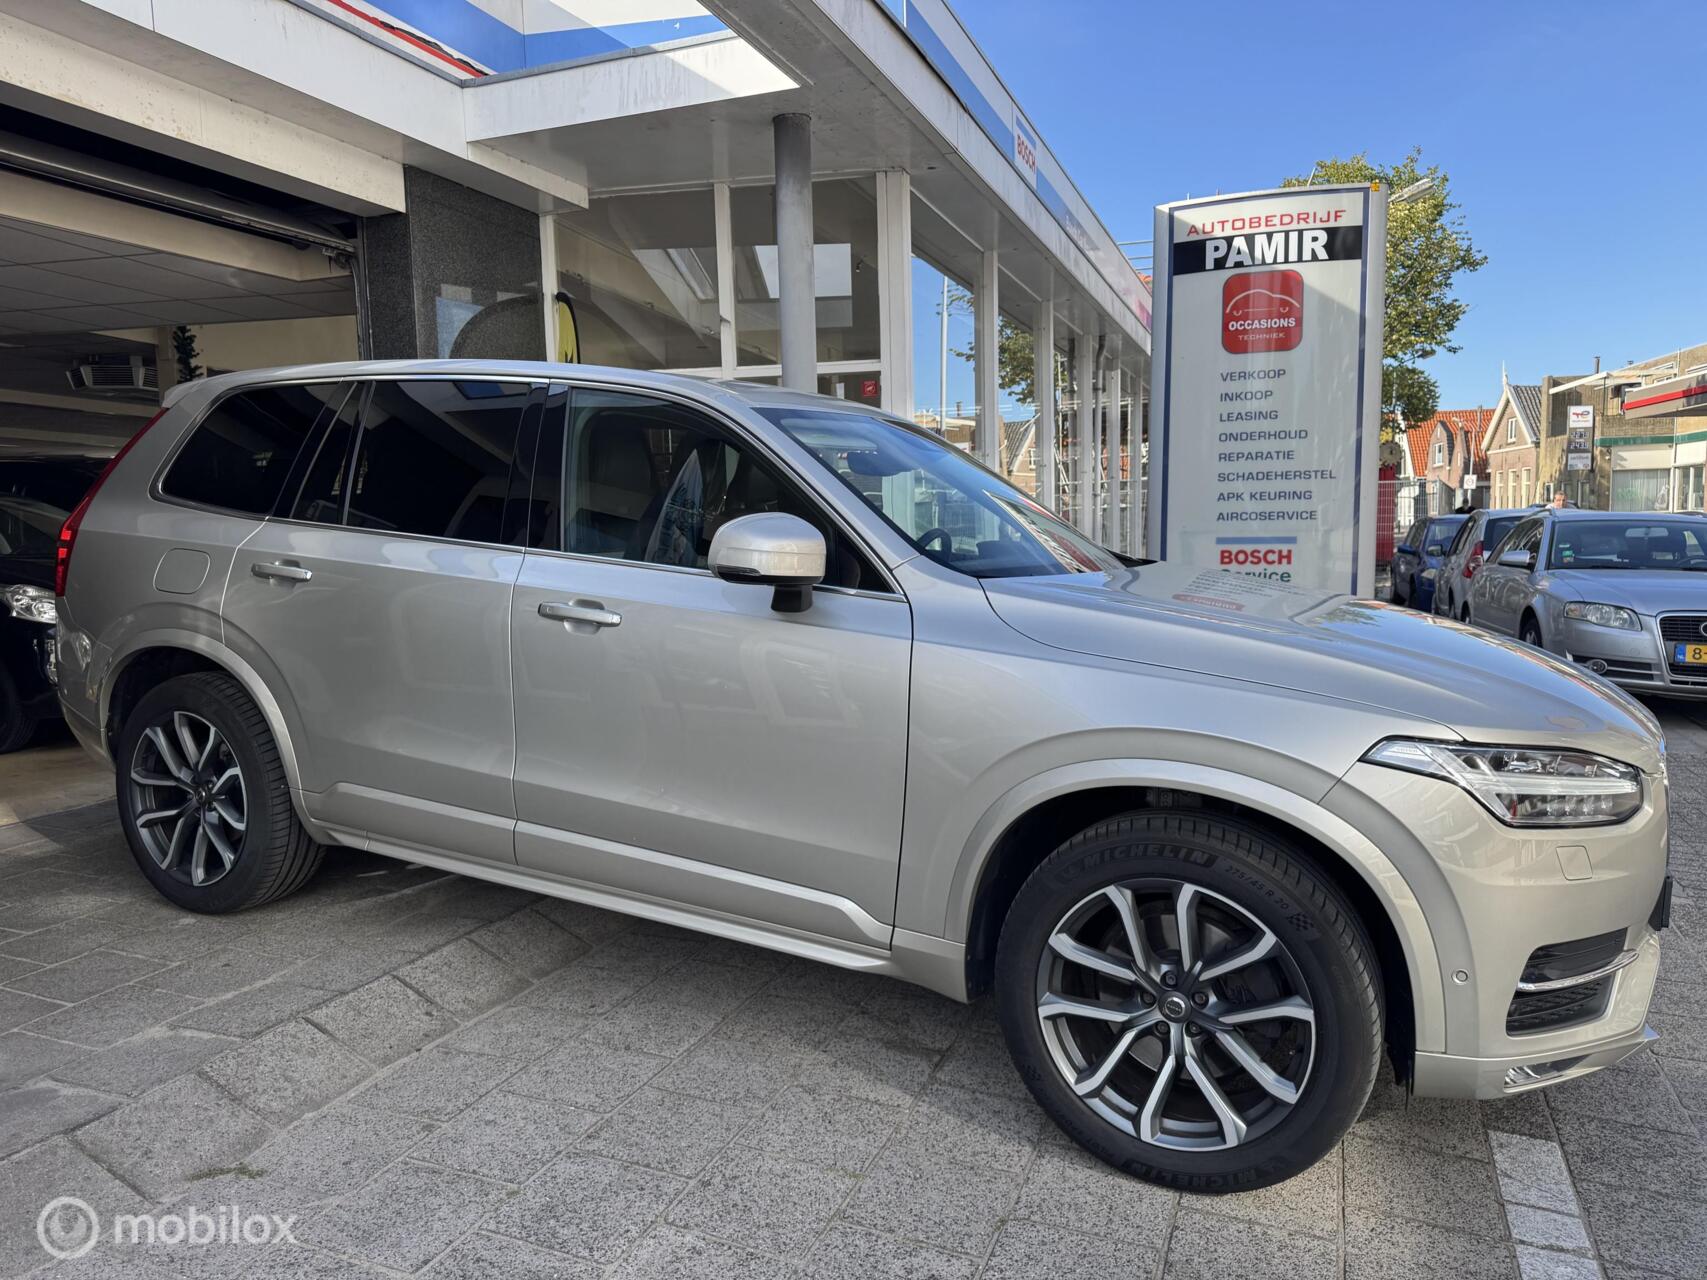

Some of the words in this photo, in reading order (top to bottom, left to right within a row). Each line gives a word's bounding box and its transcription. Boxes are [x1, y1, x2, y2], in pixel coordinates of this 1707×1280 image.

[1016, 133, 1036, 173] BOSCH
[1187, 209, 1346, 237] AUTOBEDRIJF
[1205, 229, 1329, 270] PAMIR
[1228, 317, 1296, 331] OCCASIONS
[1237, 333, 1286, 341] TECHNIEK
[1220, 369, 1287, 382] VERKOOP
[1220, 390, 1273, 402] INKOOP
[1219, 410, 1279, 423] LEASING
[1218, 429, 1308, 443] ONDERHOUD
[1218, 450, 1295, 462] REPARATIE
[1217, 469, 1337, 482] SCHADEHERSTEL
[1217, 491, 1245, 502] APK
[1249, 490, 1313, 502] KEURING
[1216, 510, 1318, 522] AIRCOSERVICE
[1219, 549, 1293, 566] BOSCH
[1083, 844, 1210, 867] MICHELIN
